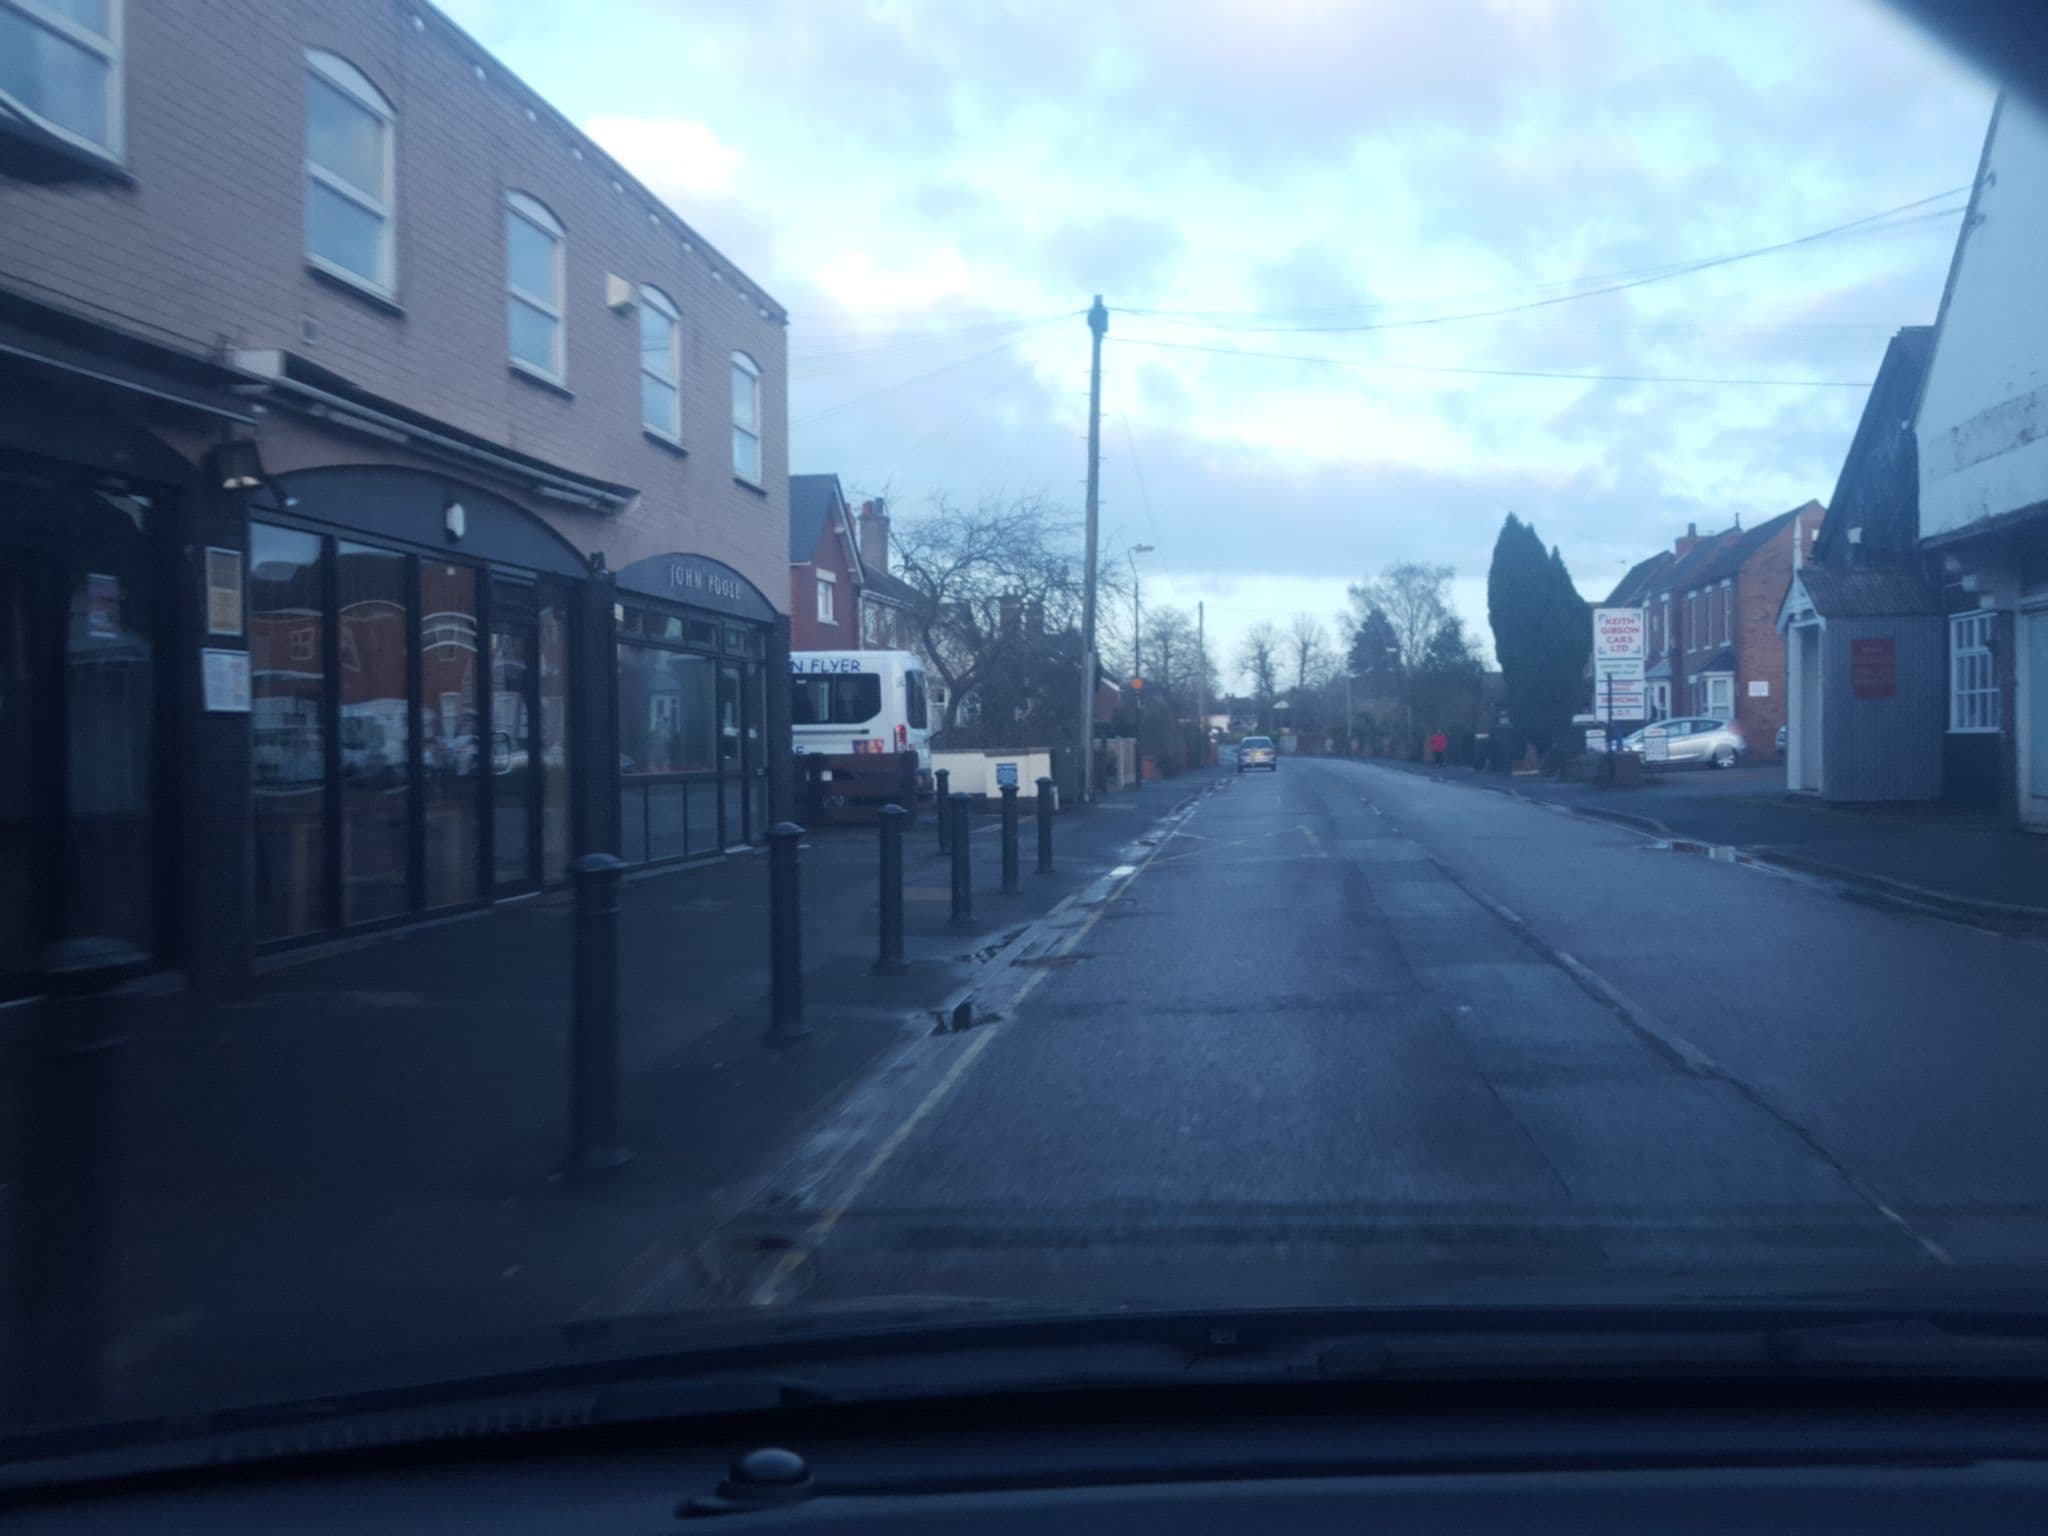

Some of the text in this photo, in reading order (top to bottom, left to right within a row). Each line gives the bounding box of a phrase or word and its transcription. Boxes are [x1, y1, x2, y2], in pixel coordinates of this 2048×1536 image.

[670, 564, 742, 600] JOHN POOLE
[1605, 617, 1634, 625] KEITH
[1600, 626, 1640, 634] GIBSON
[1606, 636, 1633, 644] CARS
[1610, 644, 1629, 653] LTD
[811, 659, 861, 673] FLYER
